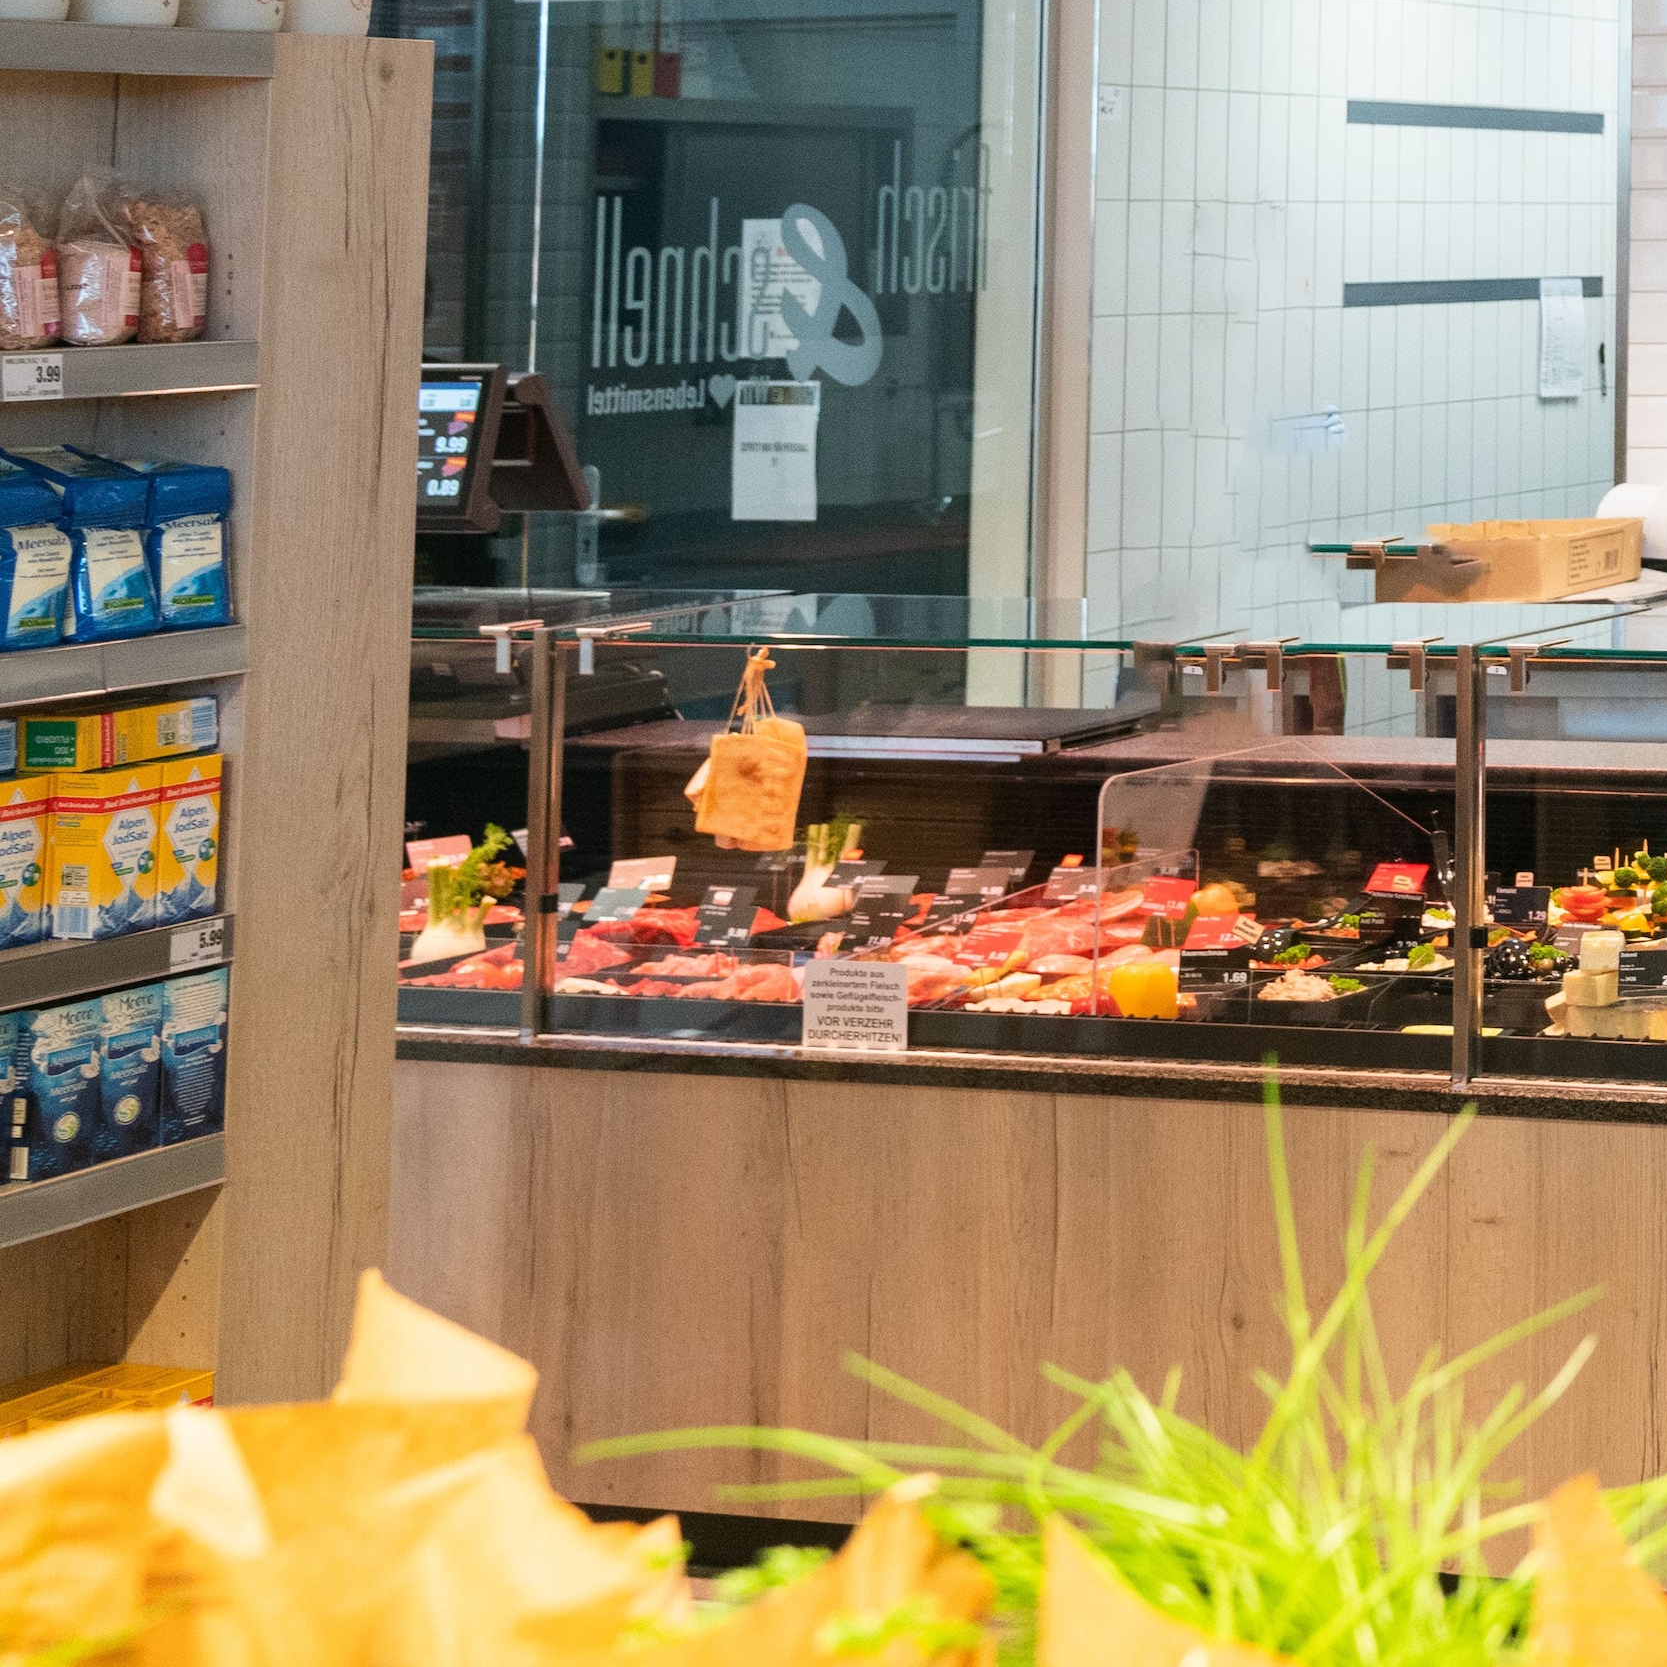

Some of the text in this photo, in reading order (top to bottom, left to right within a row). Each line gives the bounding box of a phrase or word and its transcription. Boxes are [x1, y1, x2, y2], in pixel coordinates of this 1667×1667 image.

[36, 365, 61, 383] 3.99
[17, 536, 67, 550] Meersalz
[180, 806, 207, 818] Alpen
[118, 818, 146, 830] Alpen
[174, 819, 210, 833] JodSalz
[1, 830, 31, 842] Alpen
[112, 831, 149, 846] JodSalz
[0, 843, 34, 857] odSalz
[1528, 910, 1546, 921] 1.29
[199, 931, 222, 949] 5.99
[830, 968, 884, 978] Produkte aus
[1223, 972, 1247, 983] 1.69
[812, 980, 900, 990] zerkleinertem Fleisch
[837, 992, 902, 1002] Geflügelfleisch-
[827, 1004, 885, 1013] produkte bitte
[817, 1016, 894, 1029] VOR VERZEHR
[808, 1030, 902, 1043] DURCHERHITZEN!
